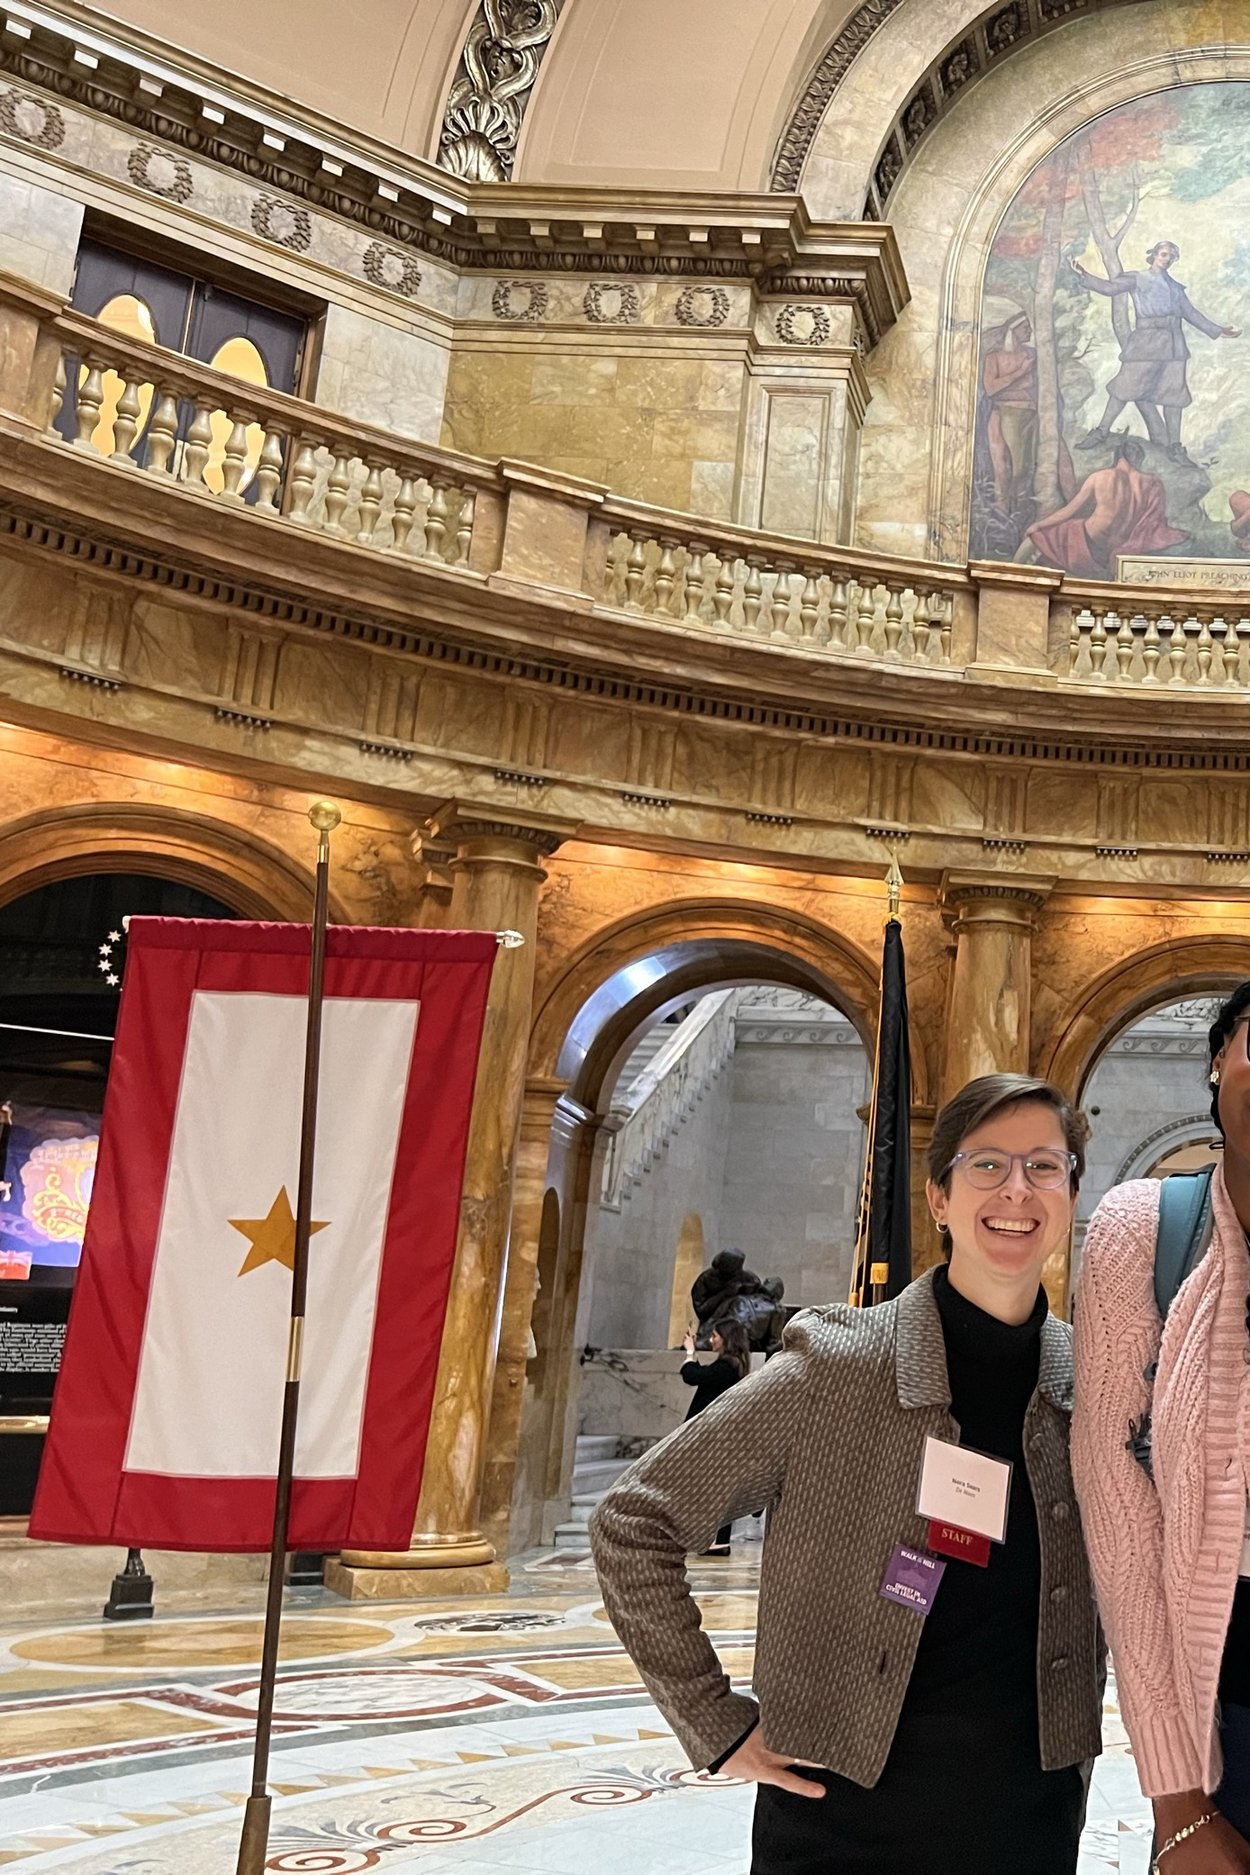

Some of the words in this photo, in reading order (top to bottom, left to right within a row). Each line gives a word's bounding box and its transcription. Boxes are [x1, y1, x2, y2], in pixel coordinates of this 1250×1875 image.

[1173, 571, 1197, 579] ELIOT
[1200, 572, 1248, 581] PREACHING
[941, 1527, 973, 1546] STAFF
[900, 1550, 918, 1562] WALK
[916, 1596, 928, 1605] AID
